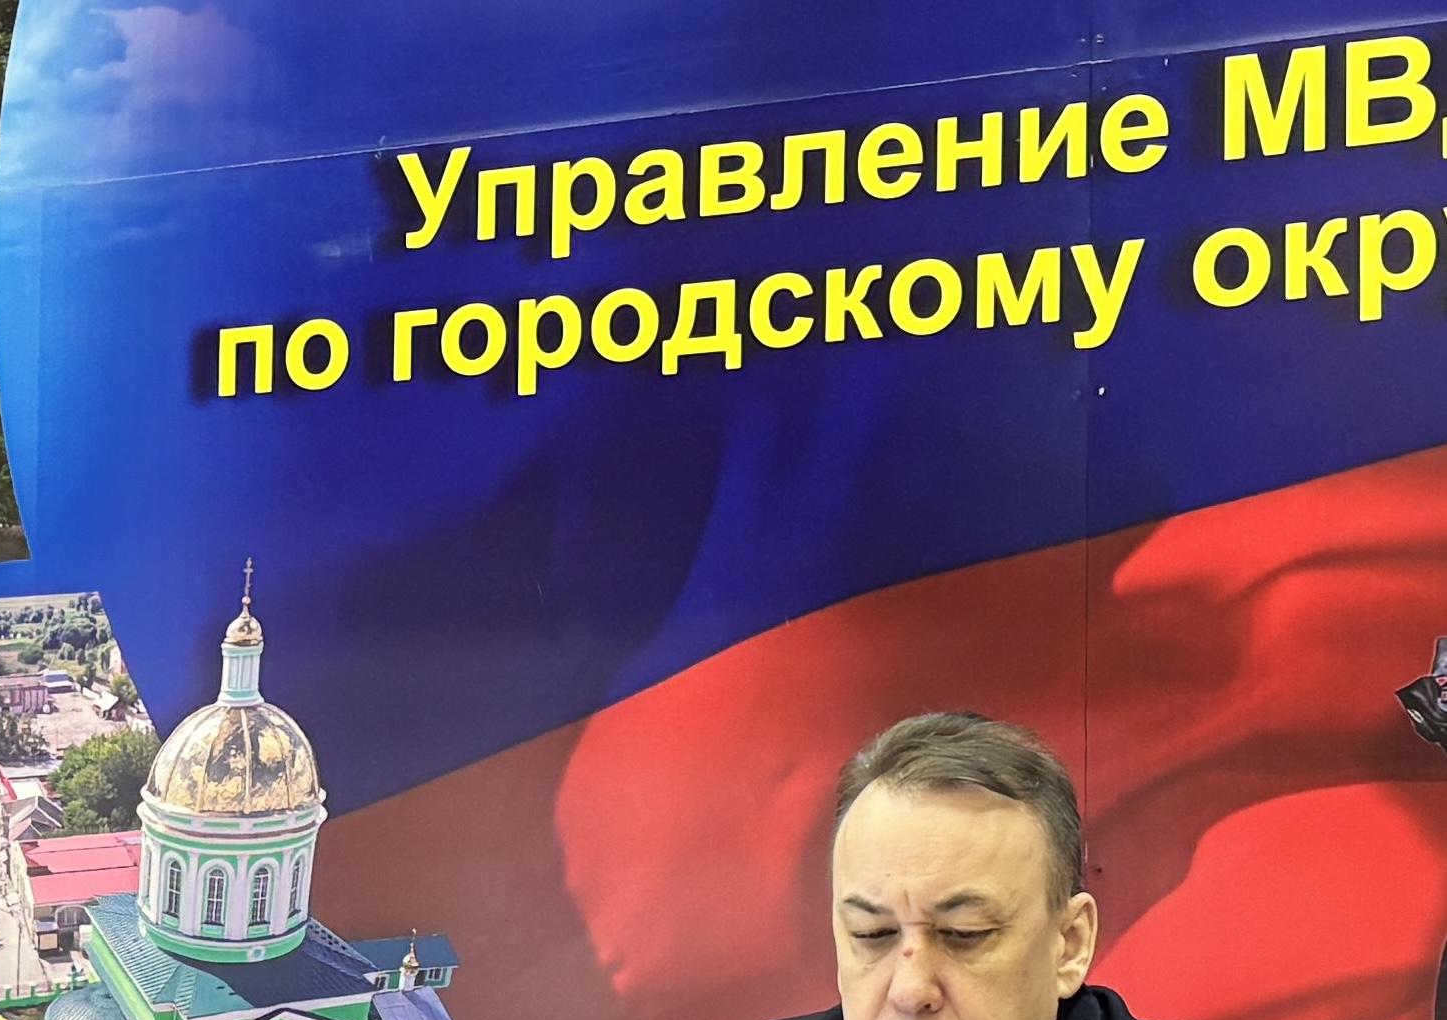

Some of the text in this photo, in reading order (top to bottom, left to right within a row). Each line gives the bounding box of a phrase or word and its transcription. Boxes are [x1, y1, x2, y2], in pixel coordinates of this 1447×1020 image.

[398, 35, 1447, 250] Управление МВ
[218, 206, 1447, 398] по городскому окр
